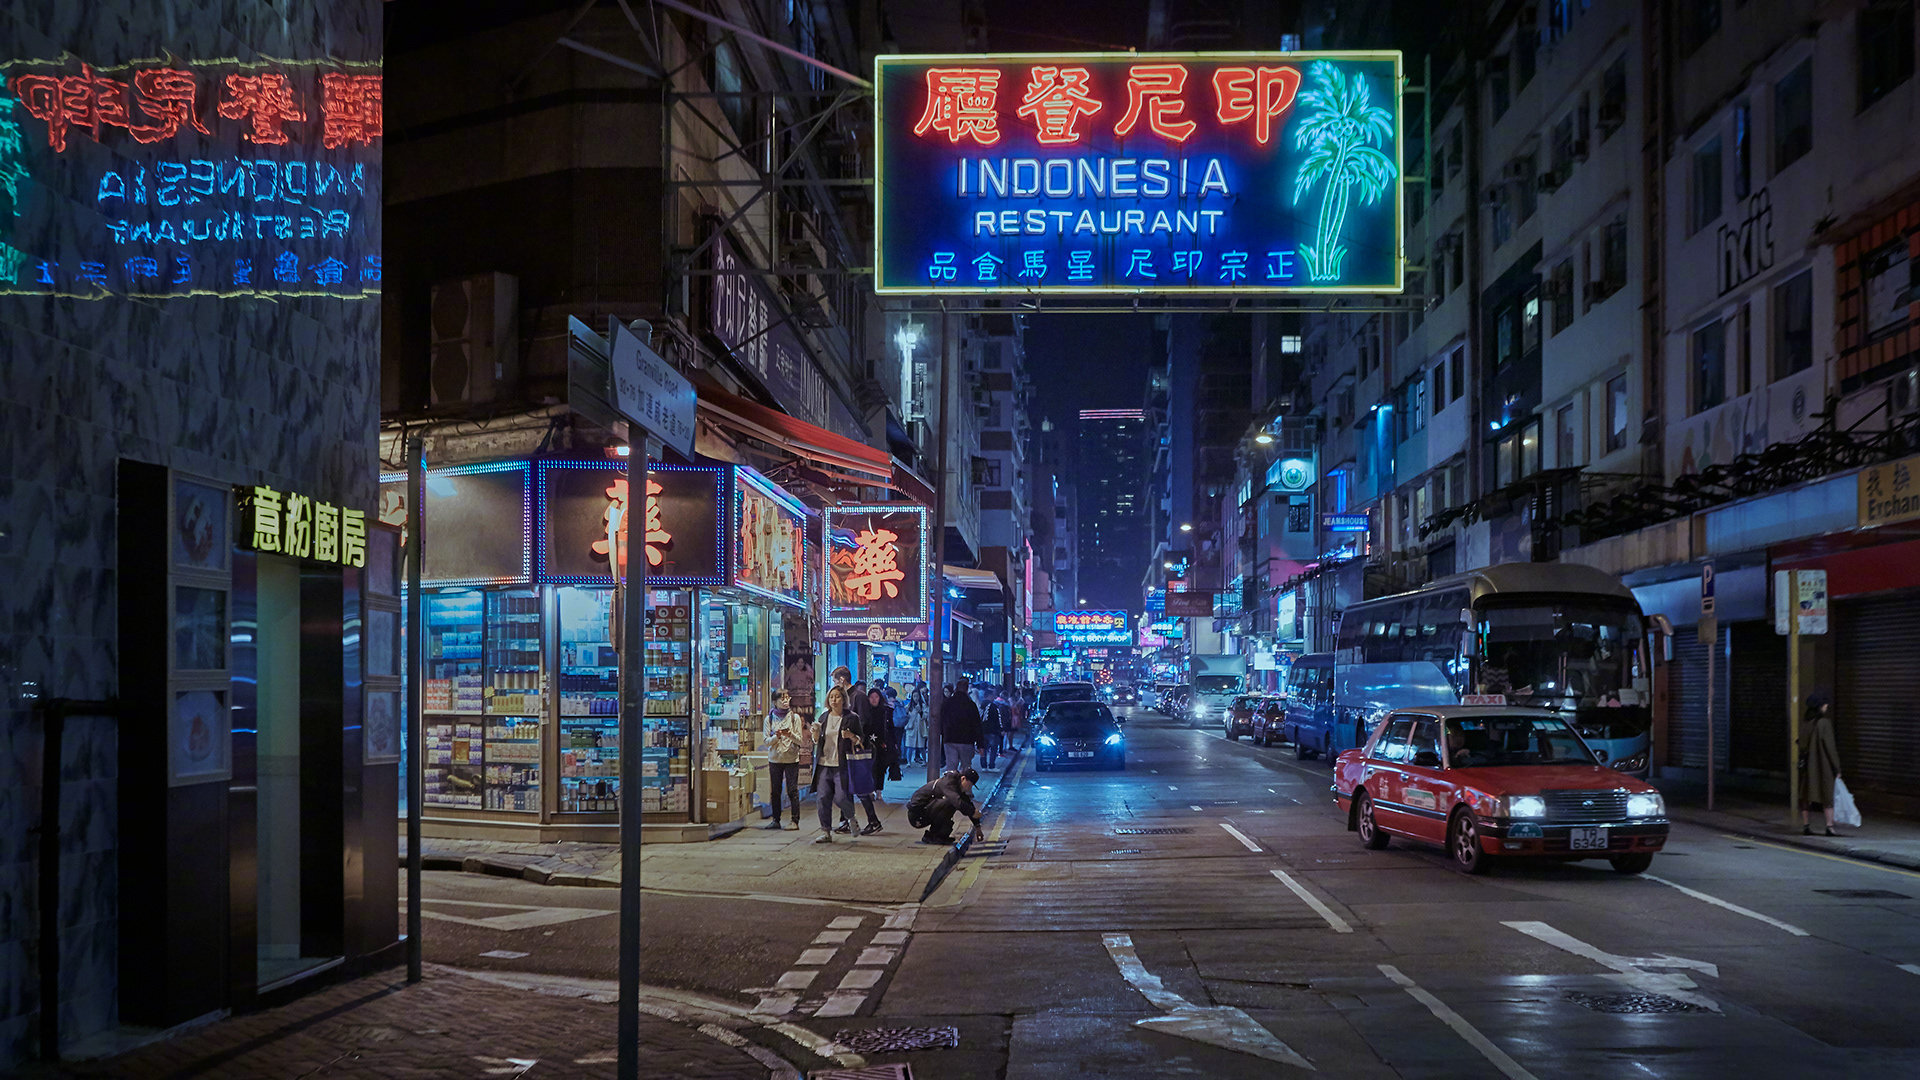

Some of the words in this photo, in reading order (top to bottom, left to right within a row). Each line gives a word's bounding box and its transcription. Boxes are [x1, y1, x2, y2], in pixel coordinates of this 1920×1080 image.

[957, 157, 1232, 199] INDONESIA
[974, 208, 1225, 237] RESTAURANT
[636, 349, 663, 388] Granville
[663, 371, 679, 400] Road
[252, 484, 366, 568] 意粉廚房
[844, 528, 906, 601] 藥
[1703, 564, 1713, 596] P
[1107, 634, 1128, 643] SHOP
[1467, 695, 1503, 704] TAXI
[1573, 838, 1606, 849] 6342
